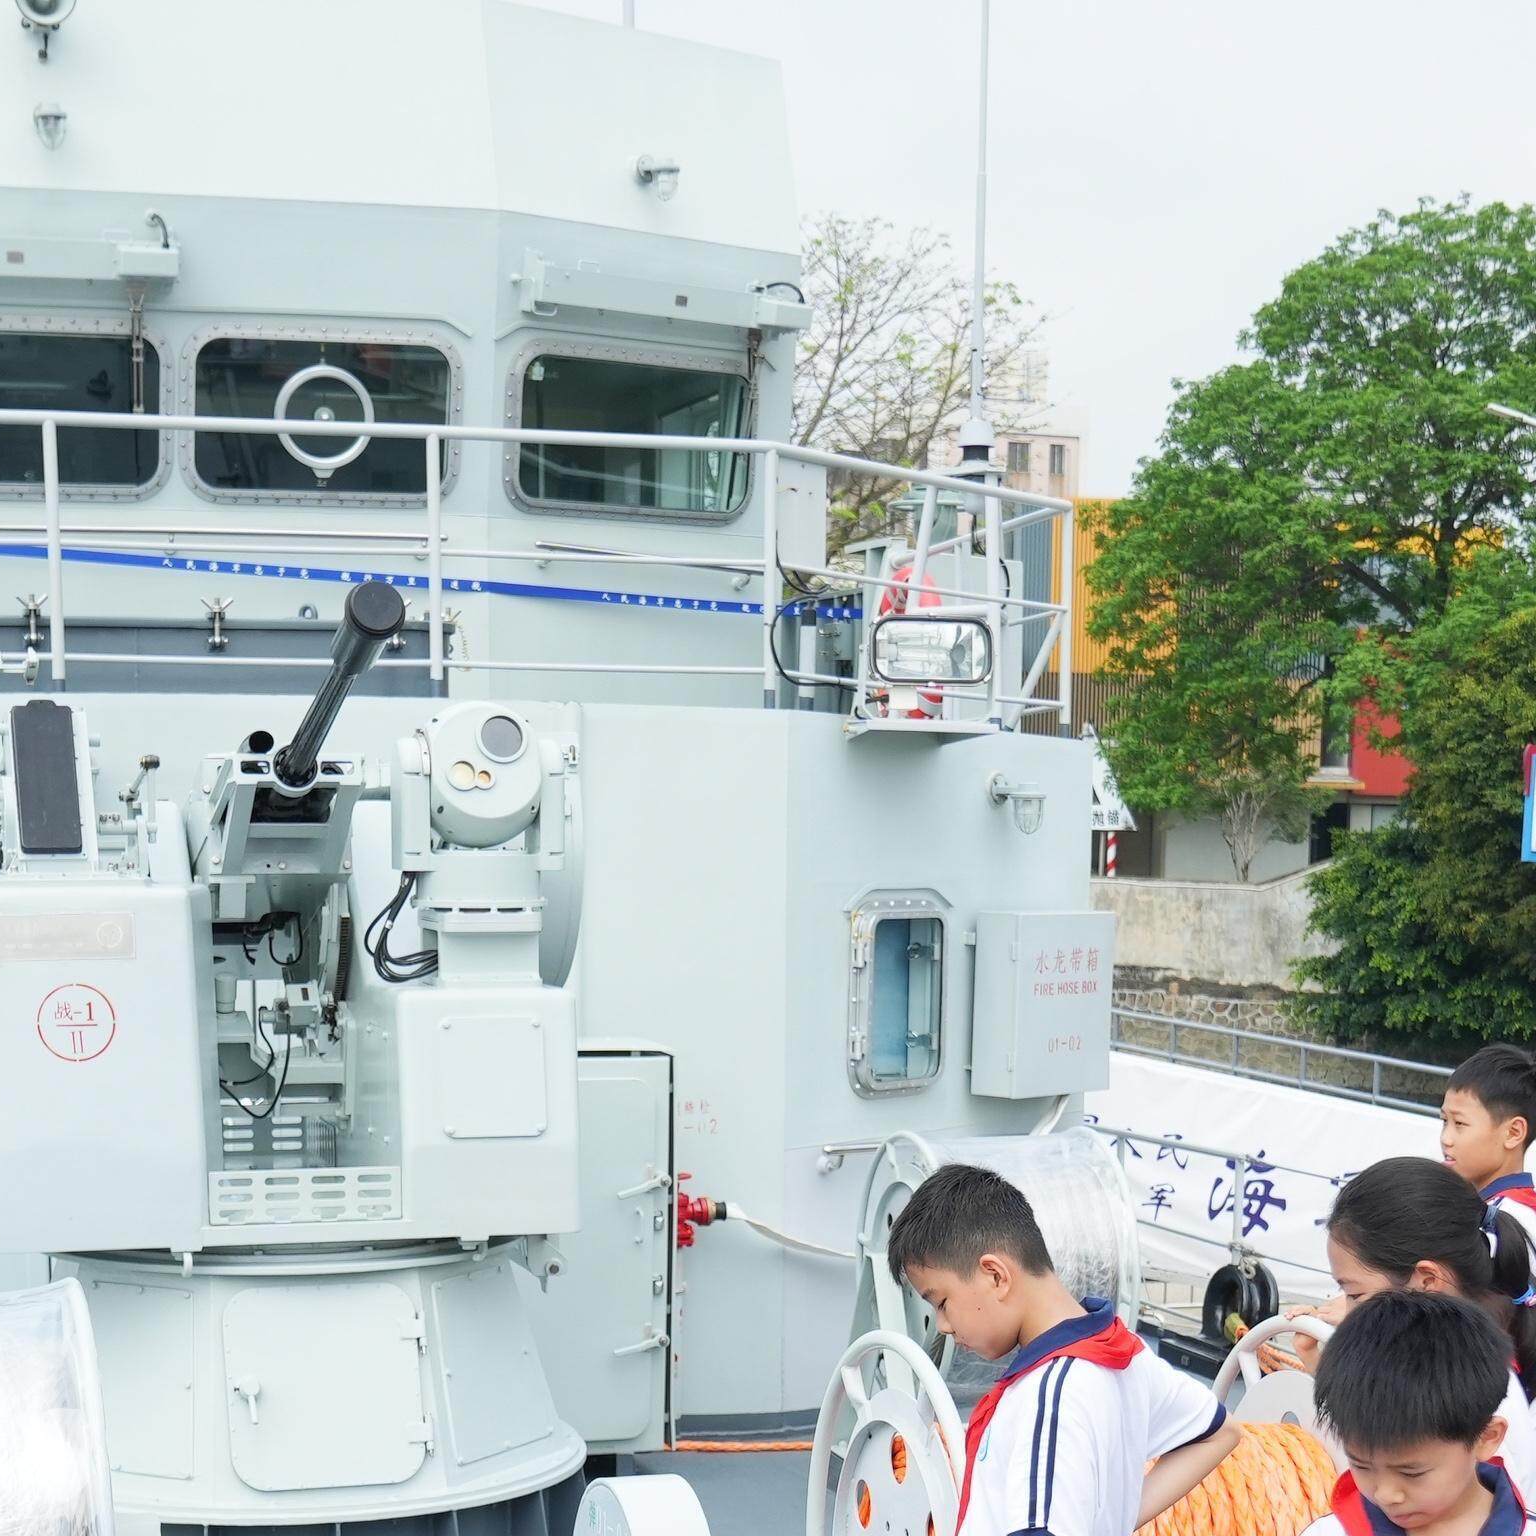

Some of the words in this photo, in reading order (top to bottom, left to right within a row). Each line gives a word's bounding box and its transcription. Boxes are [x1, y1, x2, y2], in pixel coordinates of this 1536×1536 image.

[1034, 945, 1101, 974] 水龙带箱
[1033, 983, 1055, 996] FIRE
[1057, 982, 1079, 996] HOSE
[1082, 980, 1099, 994] BOX
[1047, 1035, 1082, 1053] 01-02
